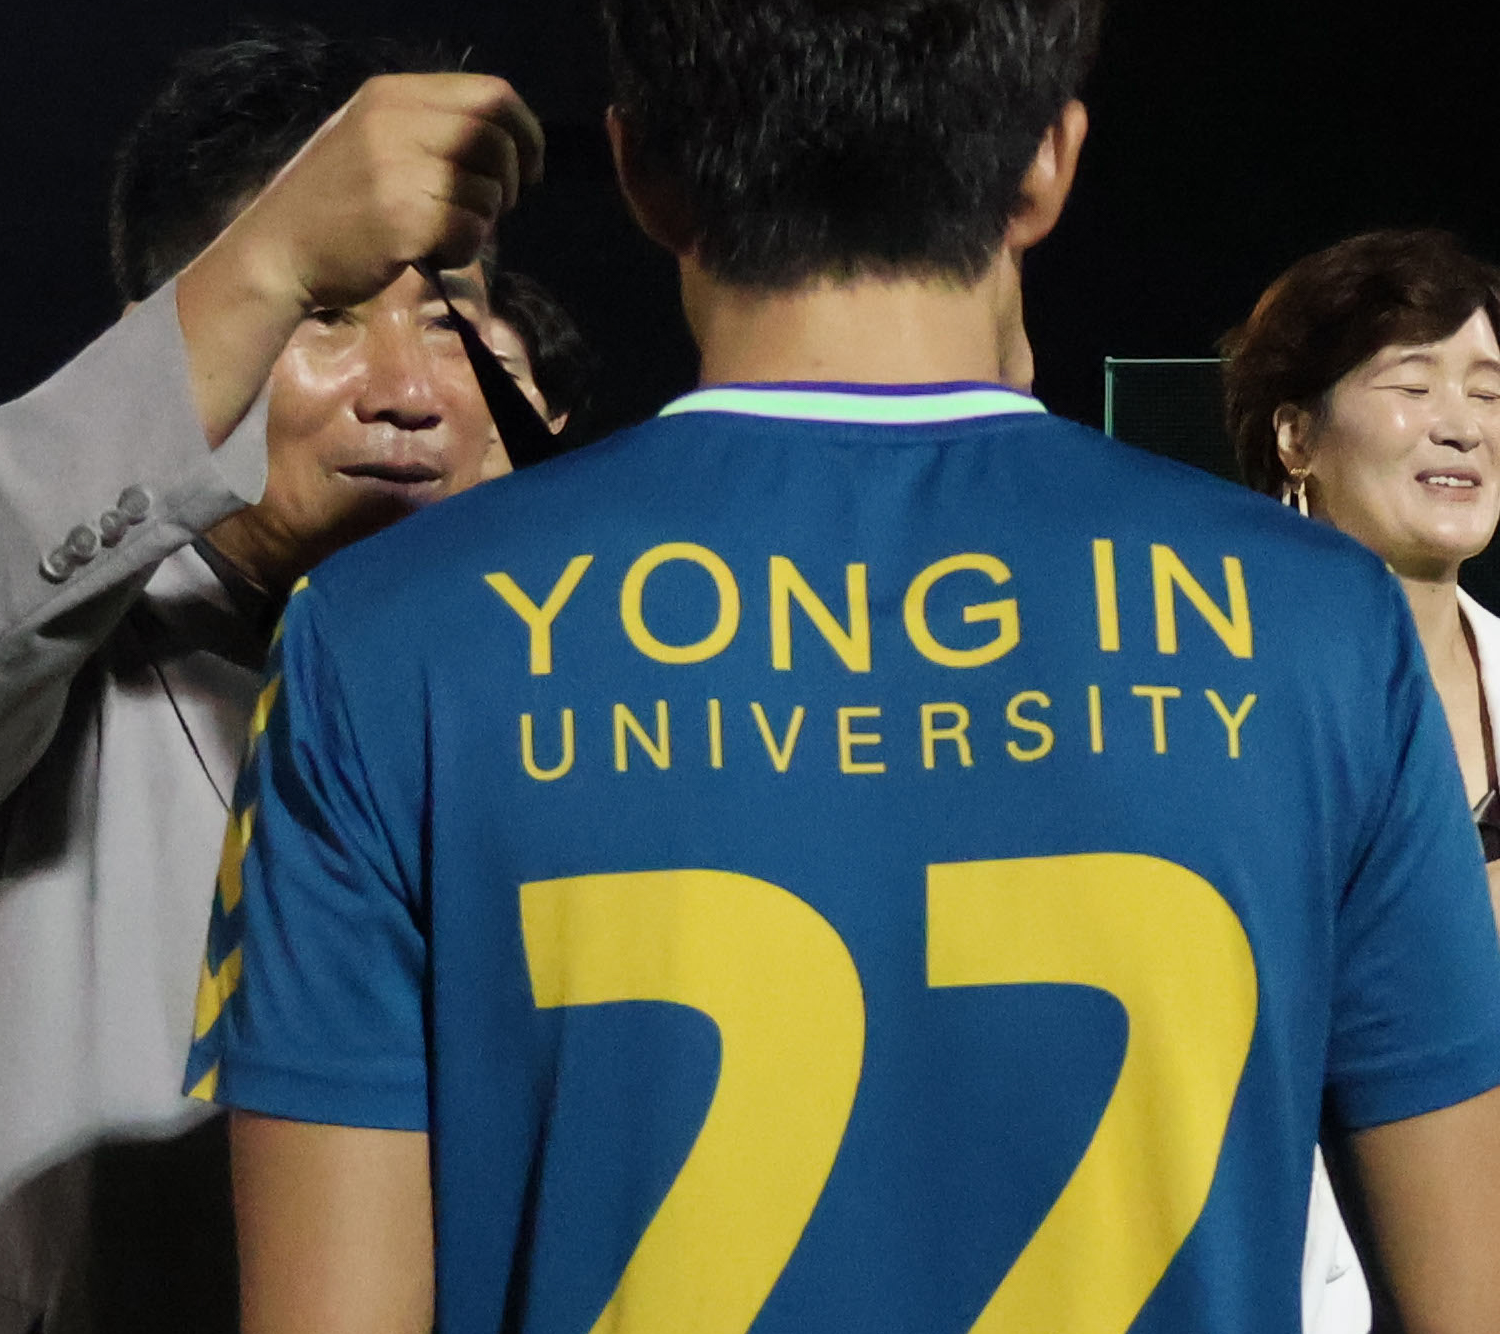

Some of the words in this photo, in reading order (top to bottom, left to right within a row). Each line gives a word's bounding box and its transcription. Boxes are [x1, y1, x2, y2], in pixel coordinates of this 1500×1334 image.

[485, 540, 1021, 677] YONG
[1093, 538, 1254, 660] IN
[520, 684, 1257, 782] UNIVERSITY
